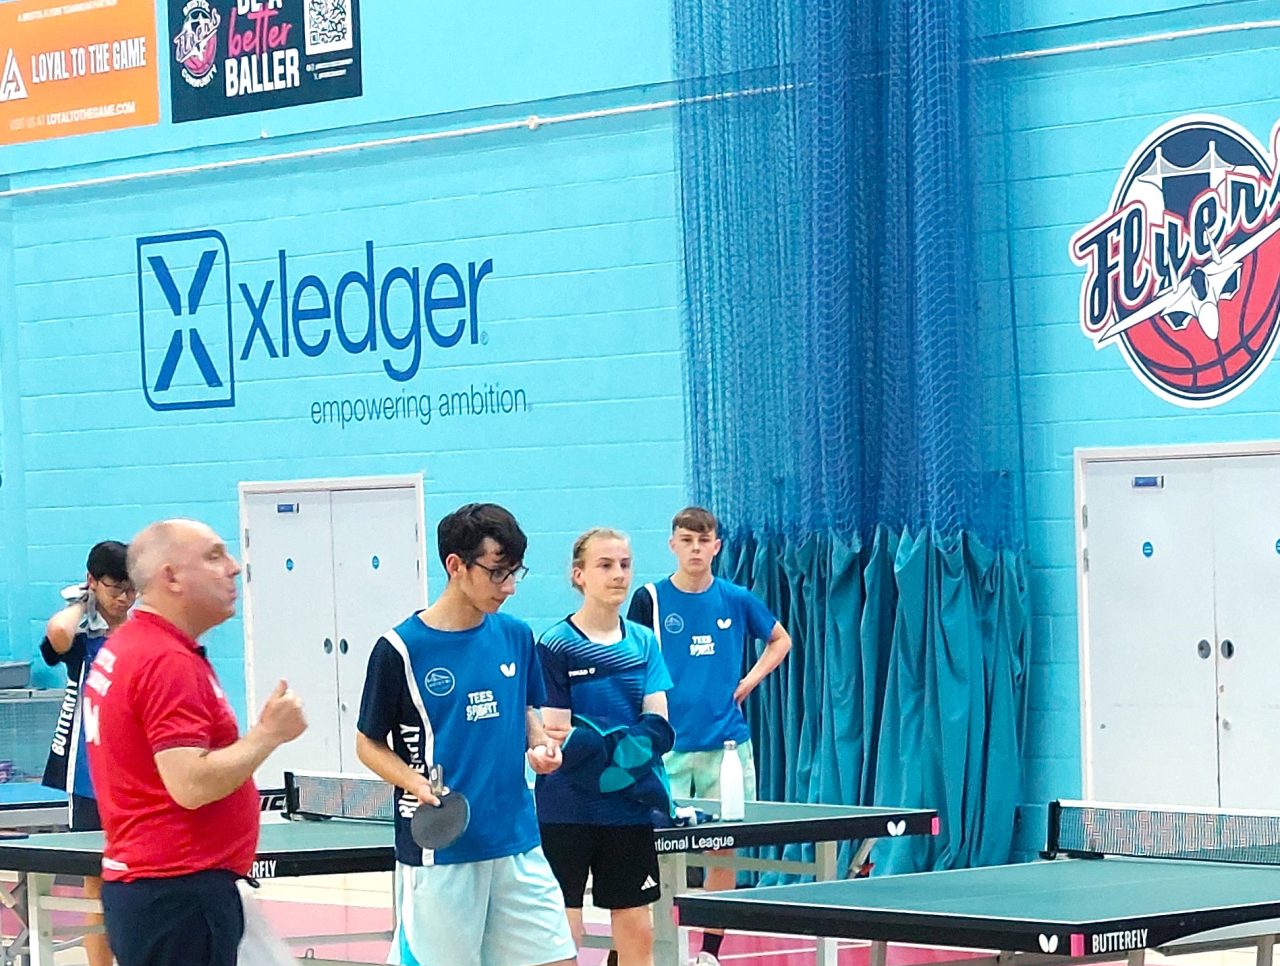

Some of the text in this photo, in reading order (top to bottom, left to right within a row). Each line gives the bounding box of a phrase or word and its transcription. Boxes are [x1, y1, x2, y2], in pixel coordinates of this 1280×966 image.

[227, 7, 292, 58] better
[31, 36, 147, 84] LOYAL TO THE GAME
[225, 48, 300, 98] BALLER
[238, 240, 493, 382] xledger
[310, 382, 527, 430] empowering ambition
[467, 690, 494, 704] TEES
[691, 835, 734, 850] League
[1092, 928, 1148, 953] BUTTERFLY
